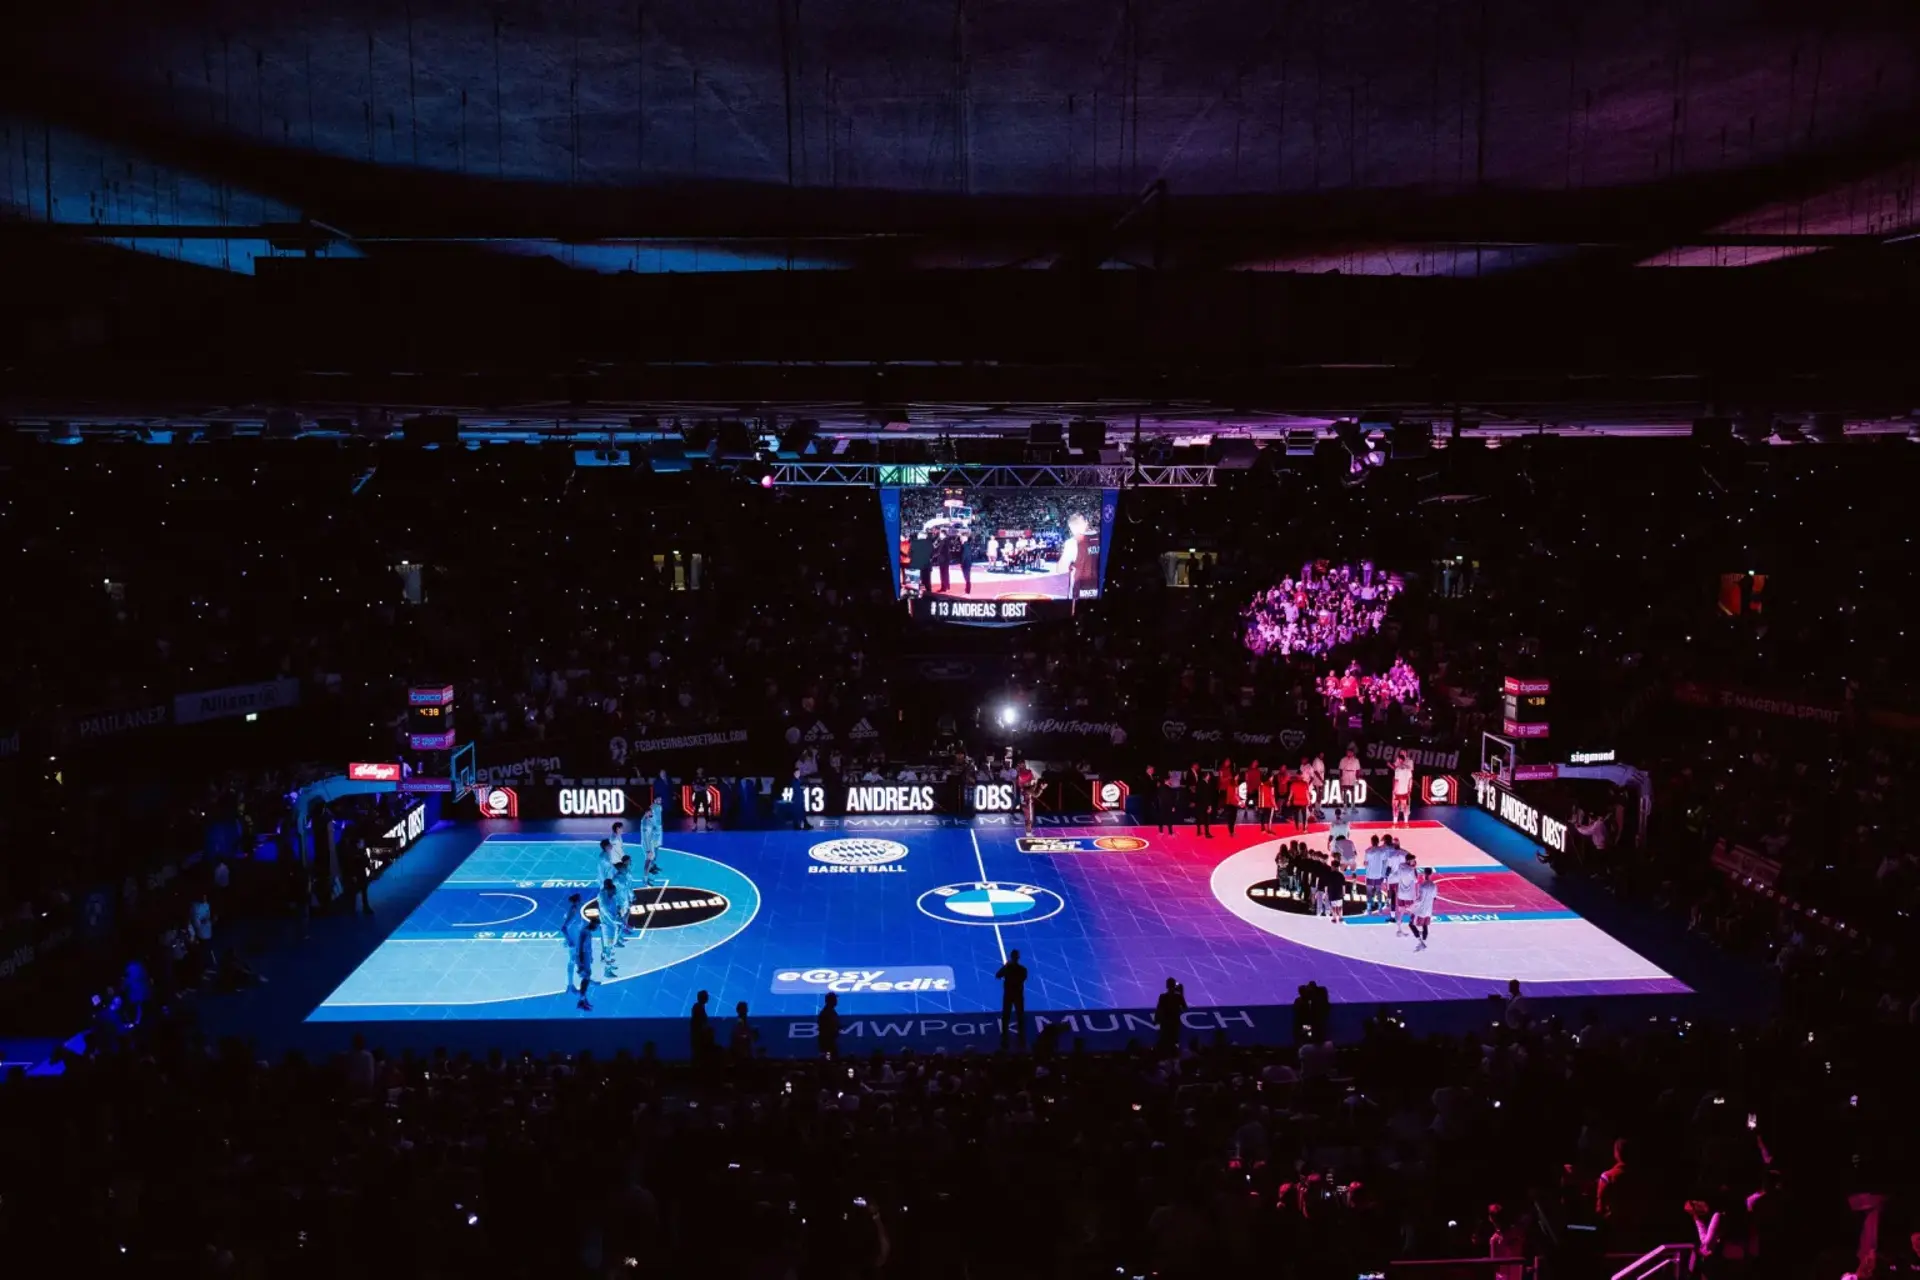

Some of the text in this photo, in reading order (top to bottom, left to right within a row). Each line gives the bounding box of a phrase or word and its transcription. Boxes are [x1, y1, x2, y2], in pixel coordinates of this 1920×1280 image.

[938, 602, 949, 616] 13
[951, 602, 996, 618] ANDREAS
[1002, 602, 1028, 617] OBST
[634, 730, 748, 752] FCBAYERNBASKETBALL.COM
[1570, 750, 1615, 764] siegmund
[558, 787, 625, 815] GUARD
[781, 784, 1013, 813] # 13 ANDREAS OBS
[1500, 791, 1539, 836] ANDREAS
[1541, 814, 1567, 852] OBST
[808, 864, 907, 874] BASKETBALL
[541, 879, 593, 888] BMW
[584, 895, 726, 917] sgmund
[1448, 912, 1500, 922] BMW
[501, 930, 560, 940] BMW
[828, 977, 951, 993] Credit
[1035, 1010, 1256, 1034] MUNCH
